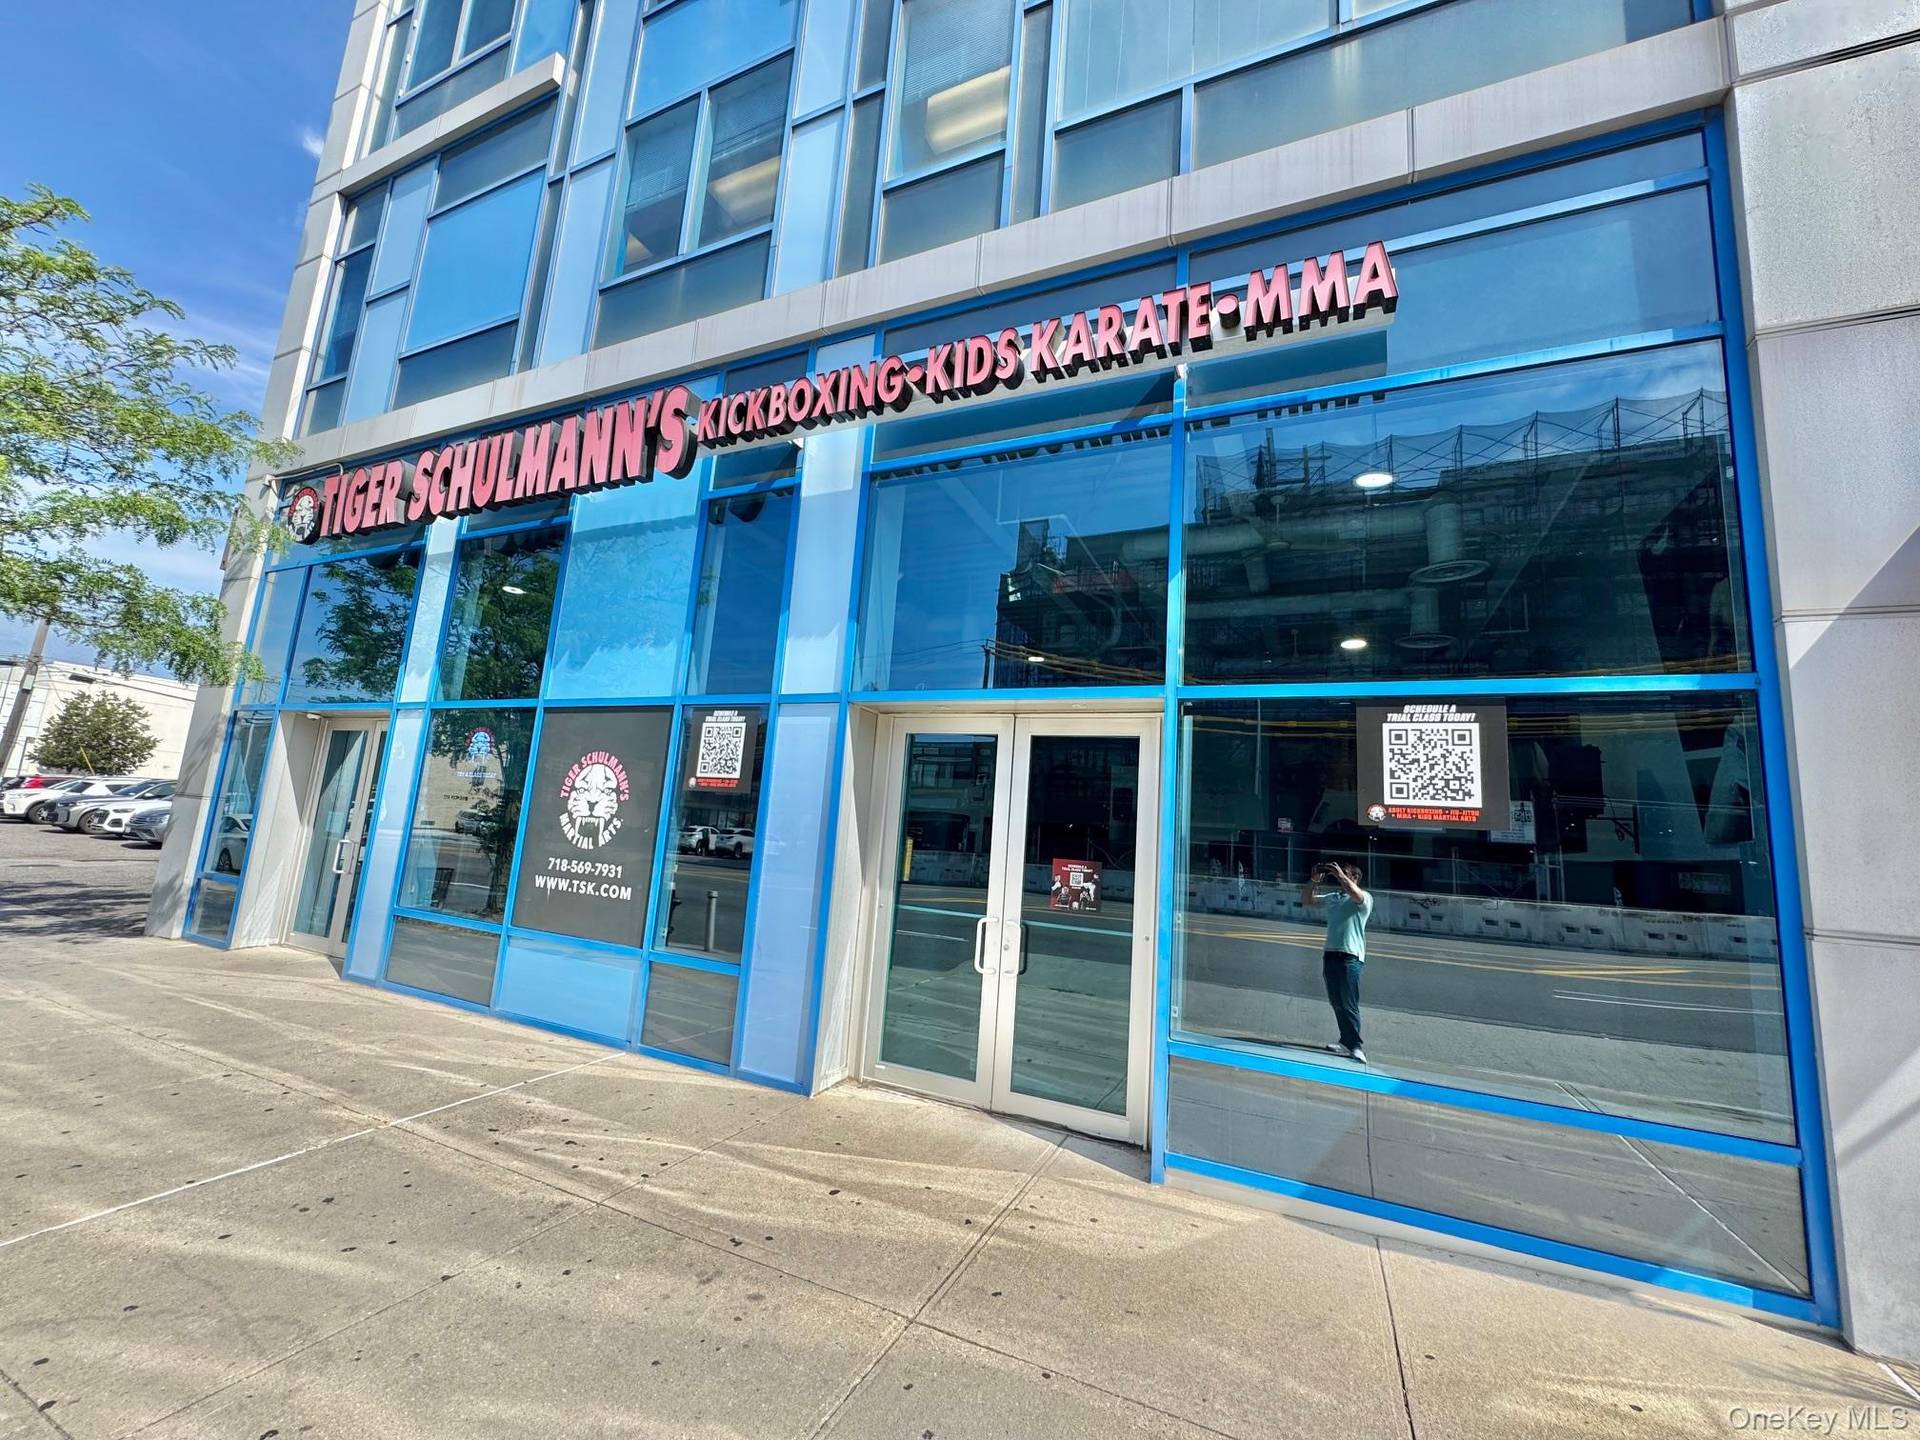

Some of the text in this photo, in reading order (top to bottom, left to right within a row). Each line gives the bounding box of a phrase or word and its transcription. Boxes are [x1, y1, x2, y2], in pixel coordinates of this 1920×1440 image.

[320, 240, 1399, 537] TIGER SCHULMANN'S KICKBOXING KIDS KARATE MMA
[1386, 713, 1476, 722] TRIAL CLASS TODAY!
[1403, 704, 1457, 713] SCHEDULE A
[560, 751, 629, 801] TIGER SCHULMANN'S
[559, 812, 594, 850] MARTIAL
[547, 857, 623, 879] 718-569-7931
[535, 875, 632, 900] WWW.TSK.COM
